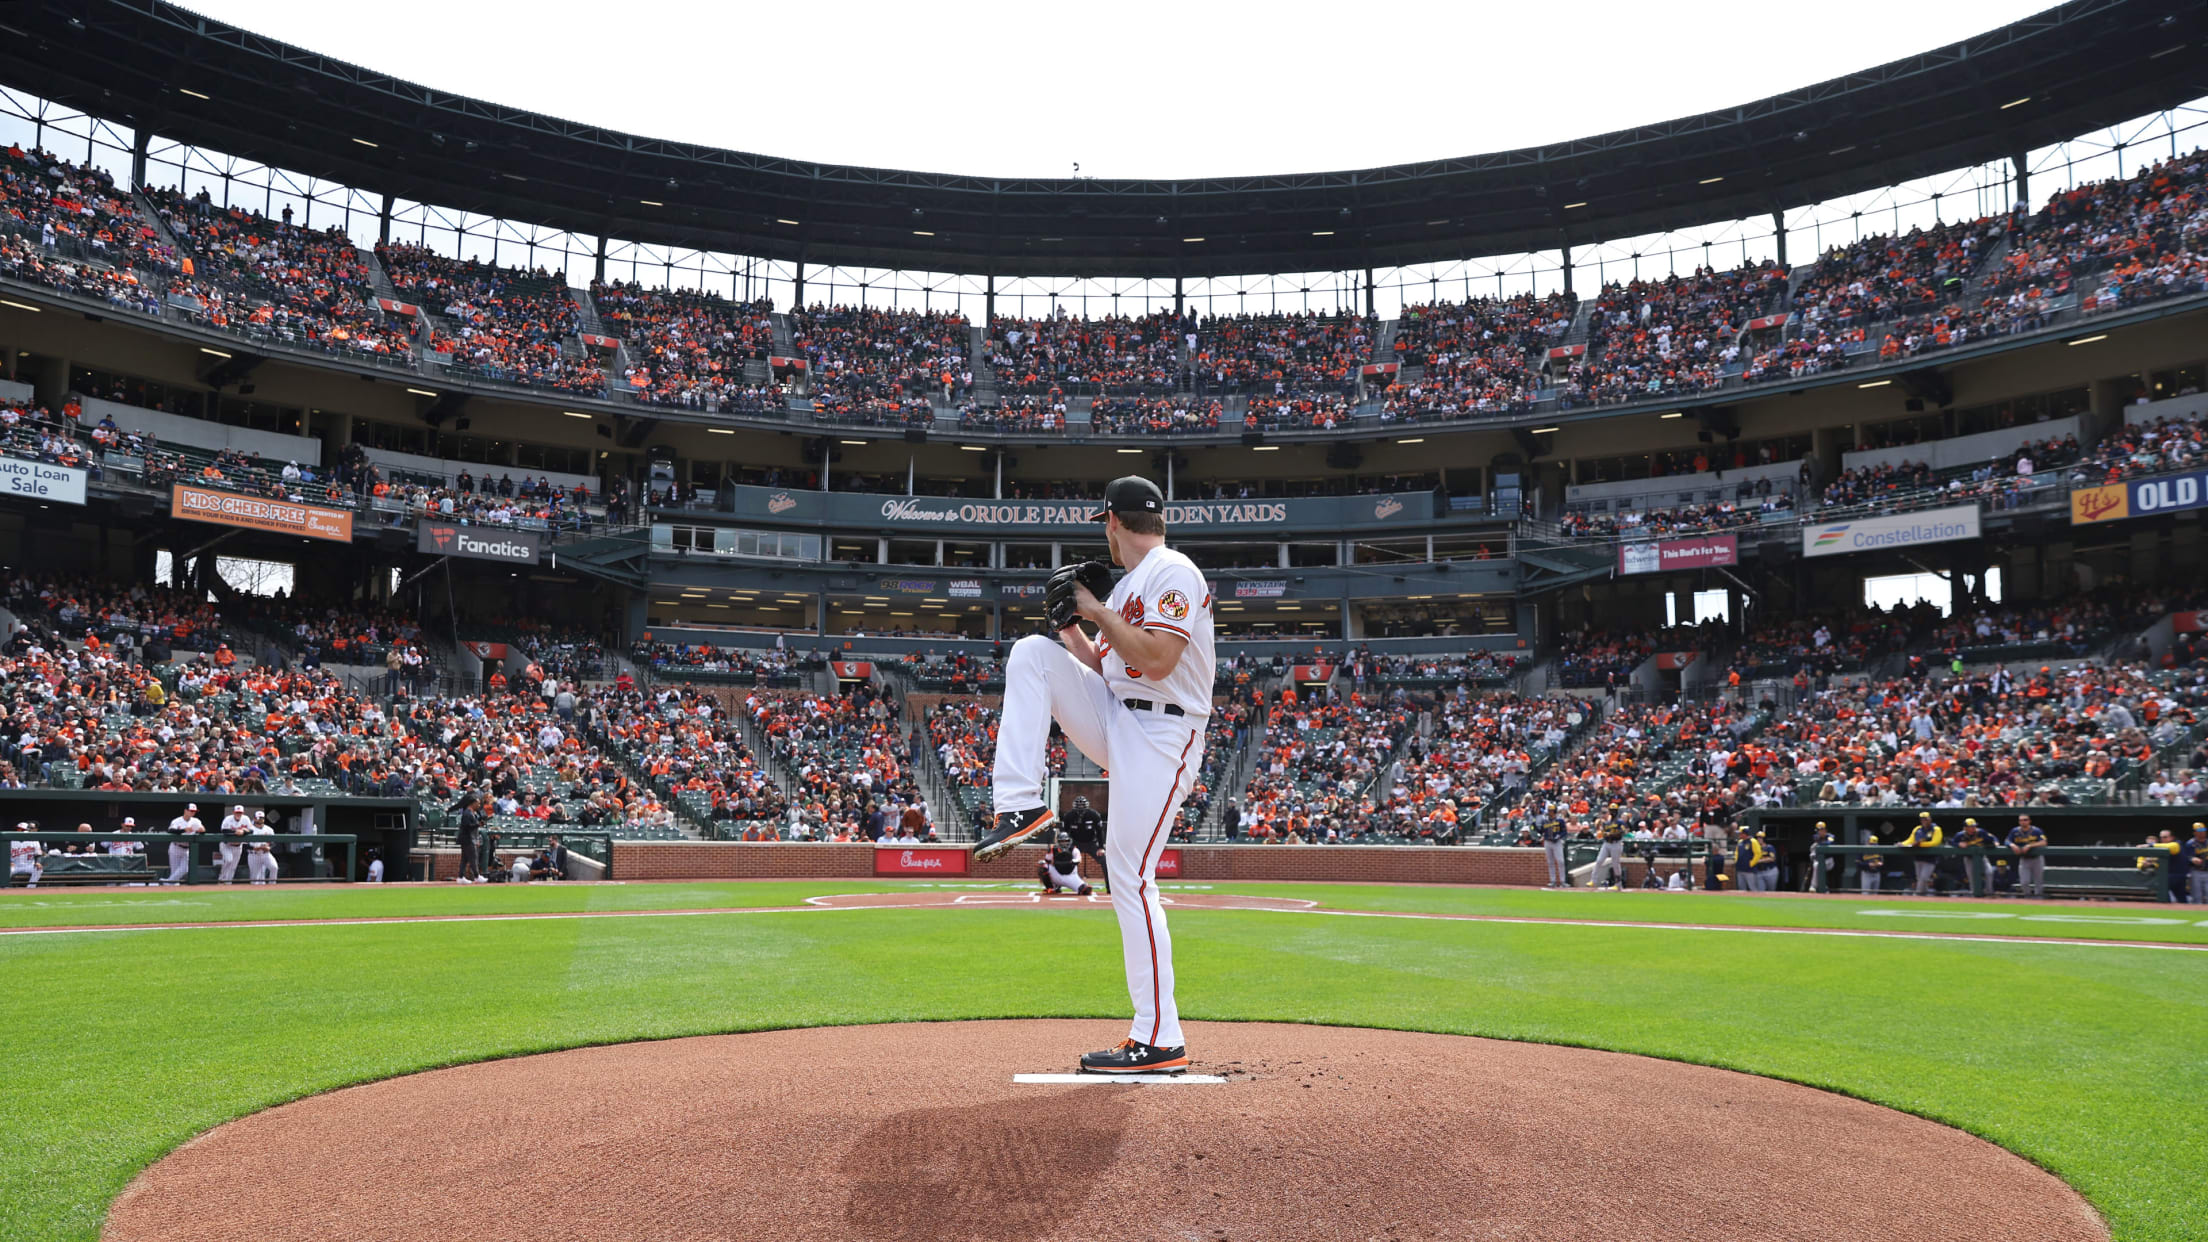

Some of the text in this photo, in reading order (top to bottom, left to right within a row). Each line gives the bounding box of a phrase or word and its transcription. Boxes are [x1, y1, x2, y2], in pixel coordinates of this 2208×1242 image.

[34, 465, 70, 482] Loan
[11, 477, 48, 495] Sale
[2137, 477, 2198, 511] OLD
[182, 490, 306, 524] KIDS CHEER FREE
[308, 509, 338, 519] PRESENTED
[881, 499, 1287, 525] Welcome to ORIOLE PARK DEN YARDS
[202, 511, 219, 519] YOUR
[254, 519, 275, 527] UNDER
[1853, 523, 1967, 548] Constellation
[457, 534, 530, 558] Fanatics
[1663, 550, 1679, 559] This
[1701, 547, 1713, 555] For
[949, 580, 980, 588] WBAL
[1235, 588, 1258, 597] 93.9
